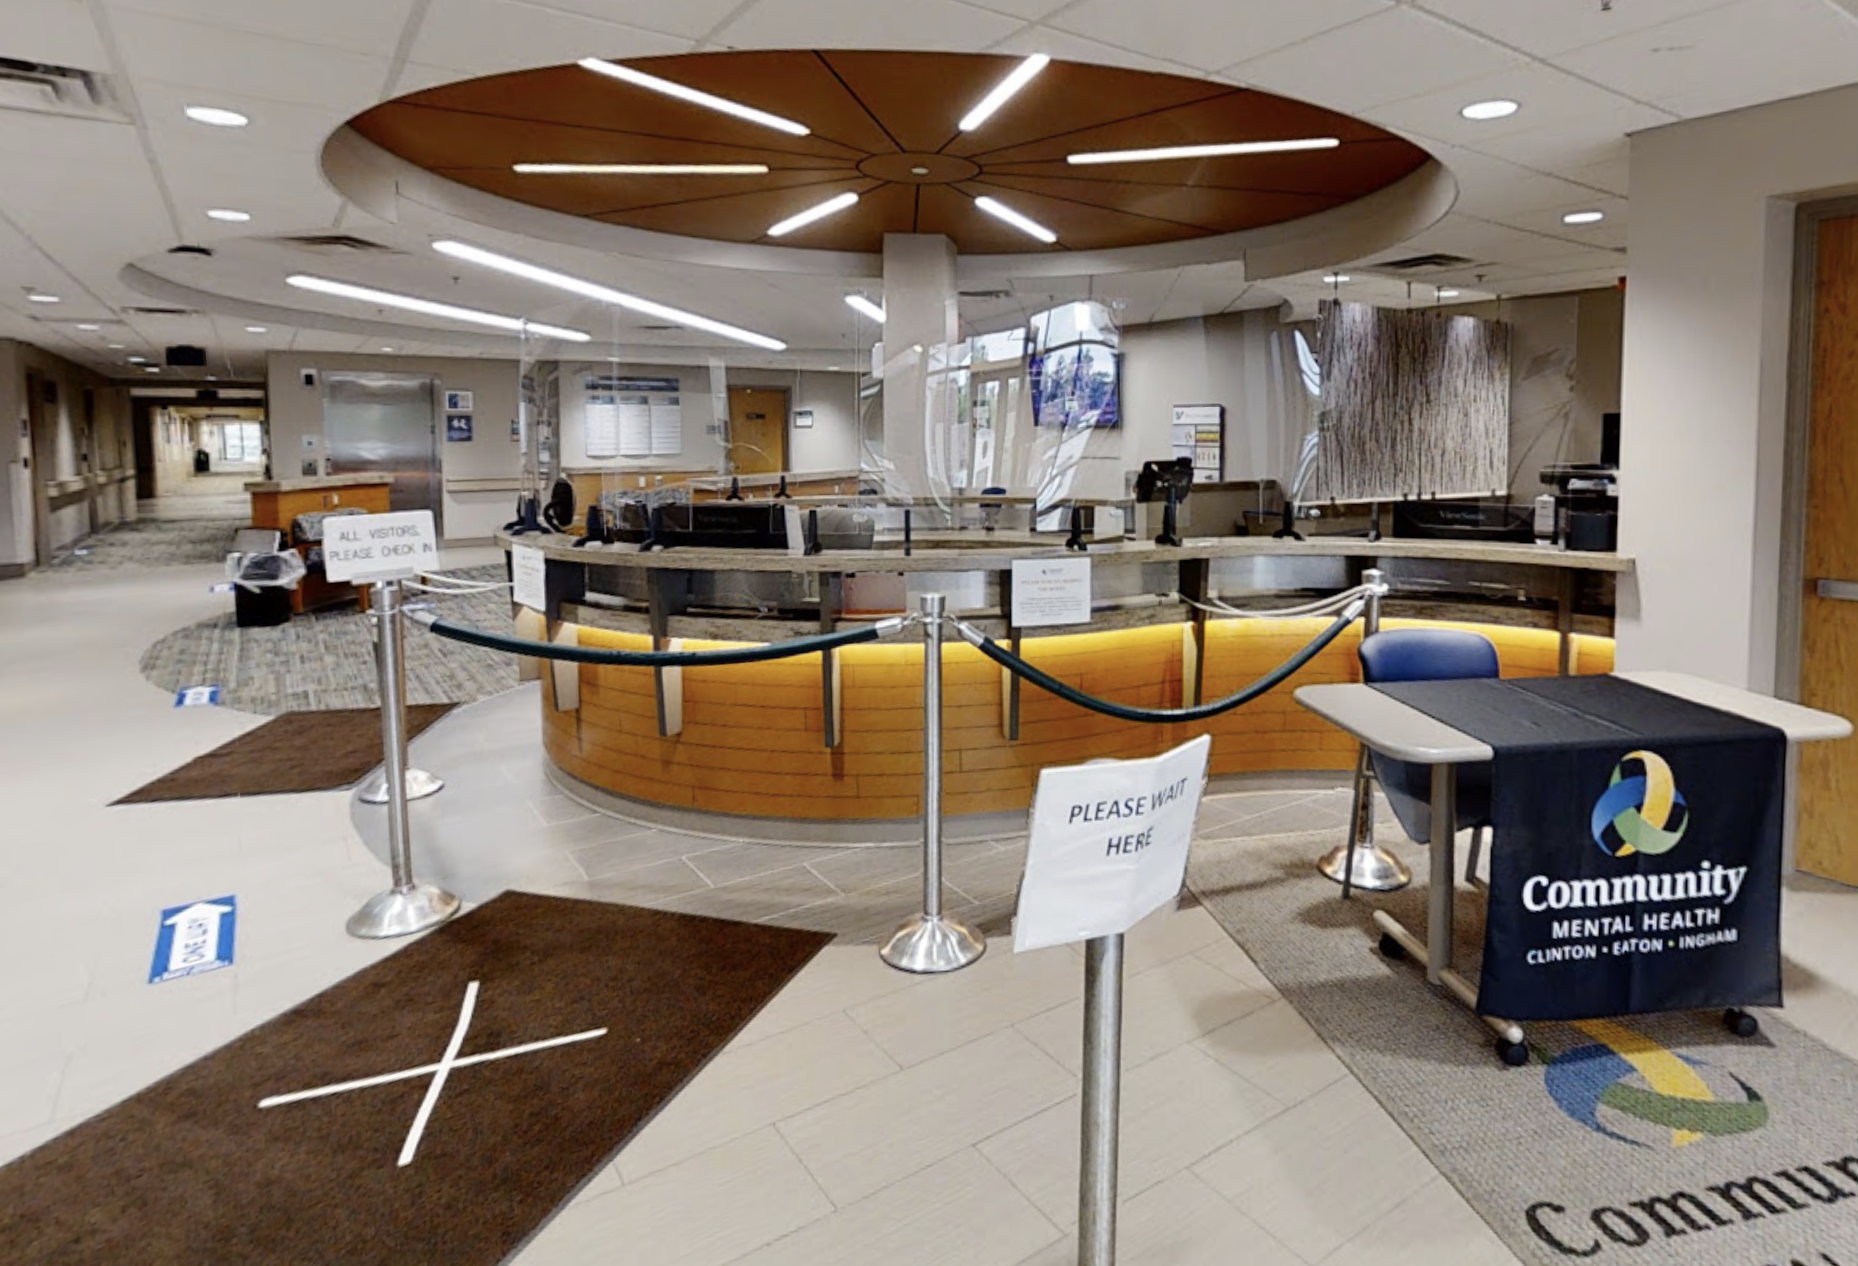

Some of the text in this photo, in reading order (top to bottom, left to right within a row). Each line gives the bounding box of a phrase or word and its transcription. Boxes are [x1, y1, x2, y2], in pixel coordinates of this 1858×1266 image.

[329, 542, 432, 561] PLEASE CHECK IN
[340, 530, 361, 541] ALL
[1069, 777, 1187, 824] PLEASE WAIT
[1106, 827, 1153, 856] HERE
[1522, 860, 1747, 912] Community
[1552, 907, 1720, 939] MENTAL HEALTH
[1527, 928, 1738, 965] CLINTON EATON INGHAM
